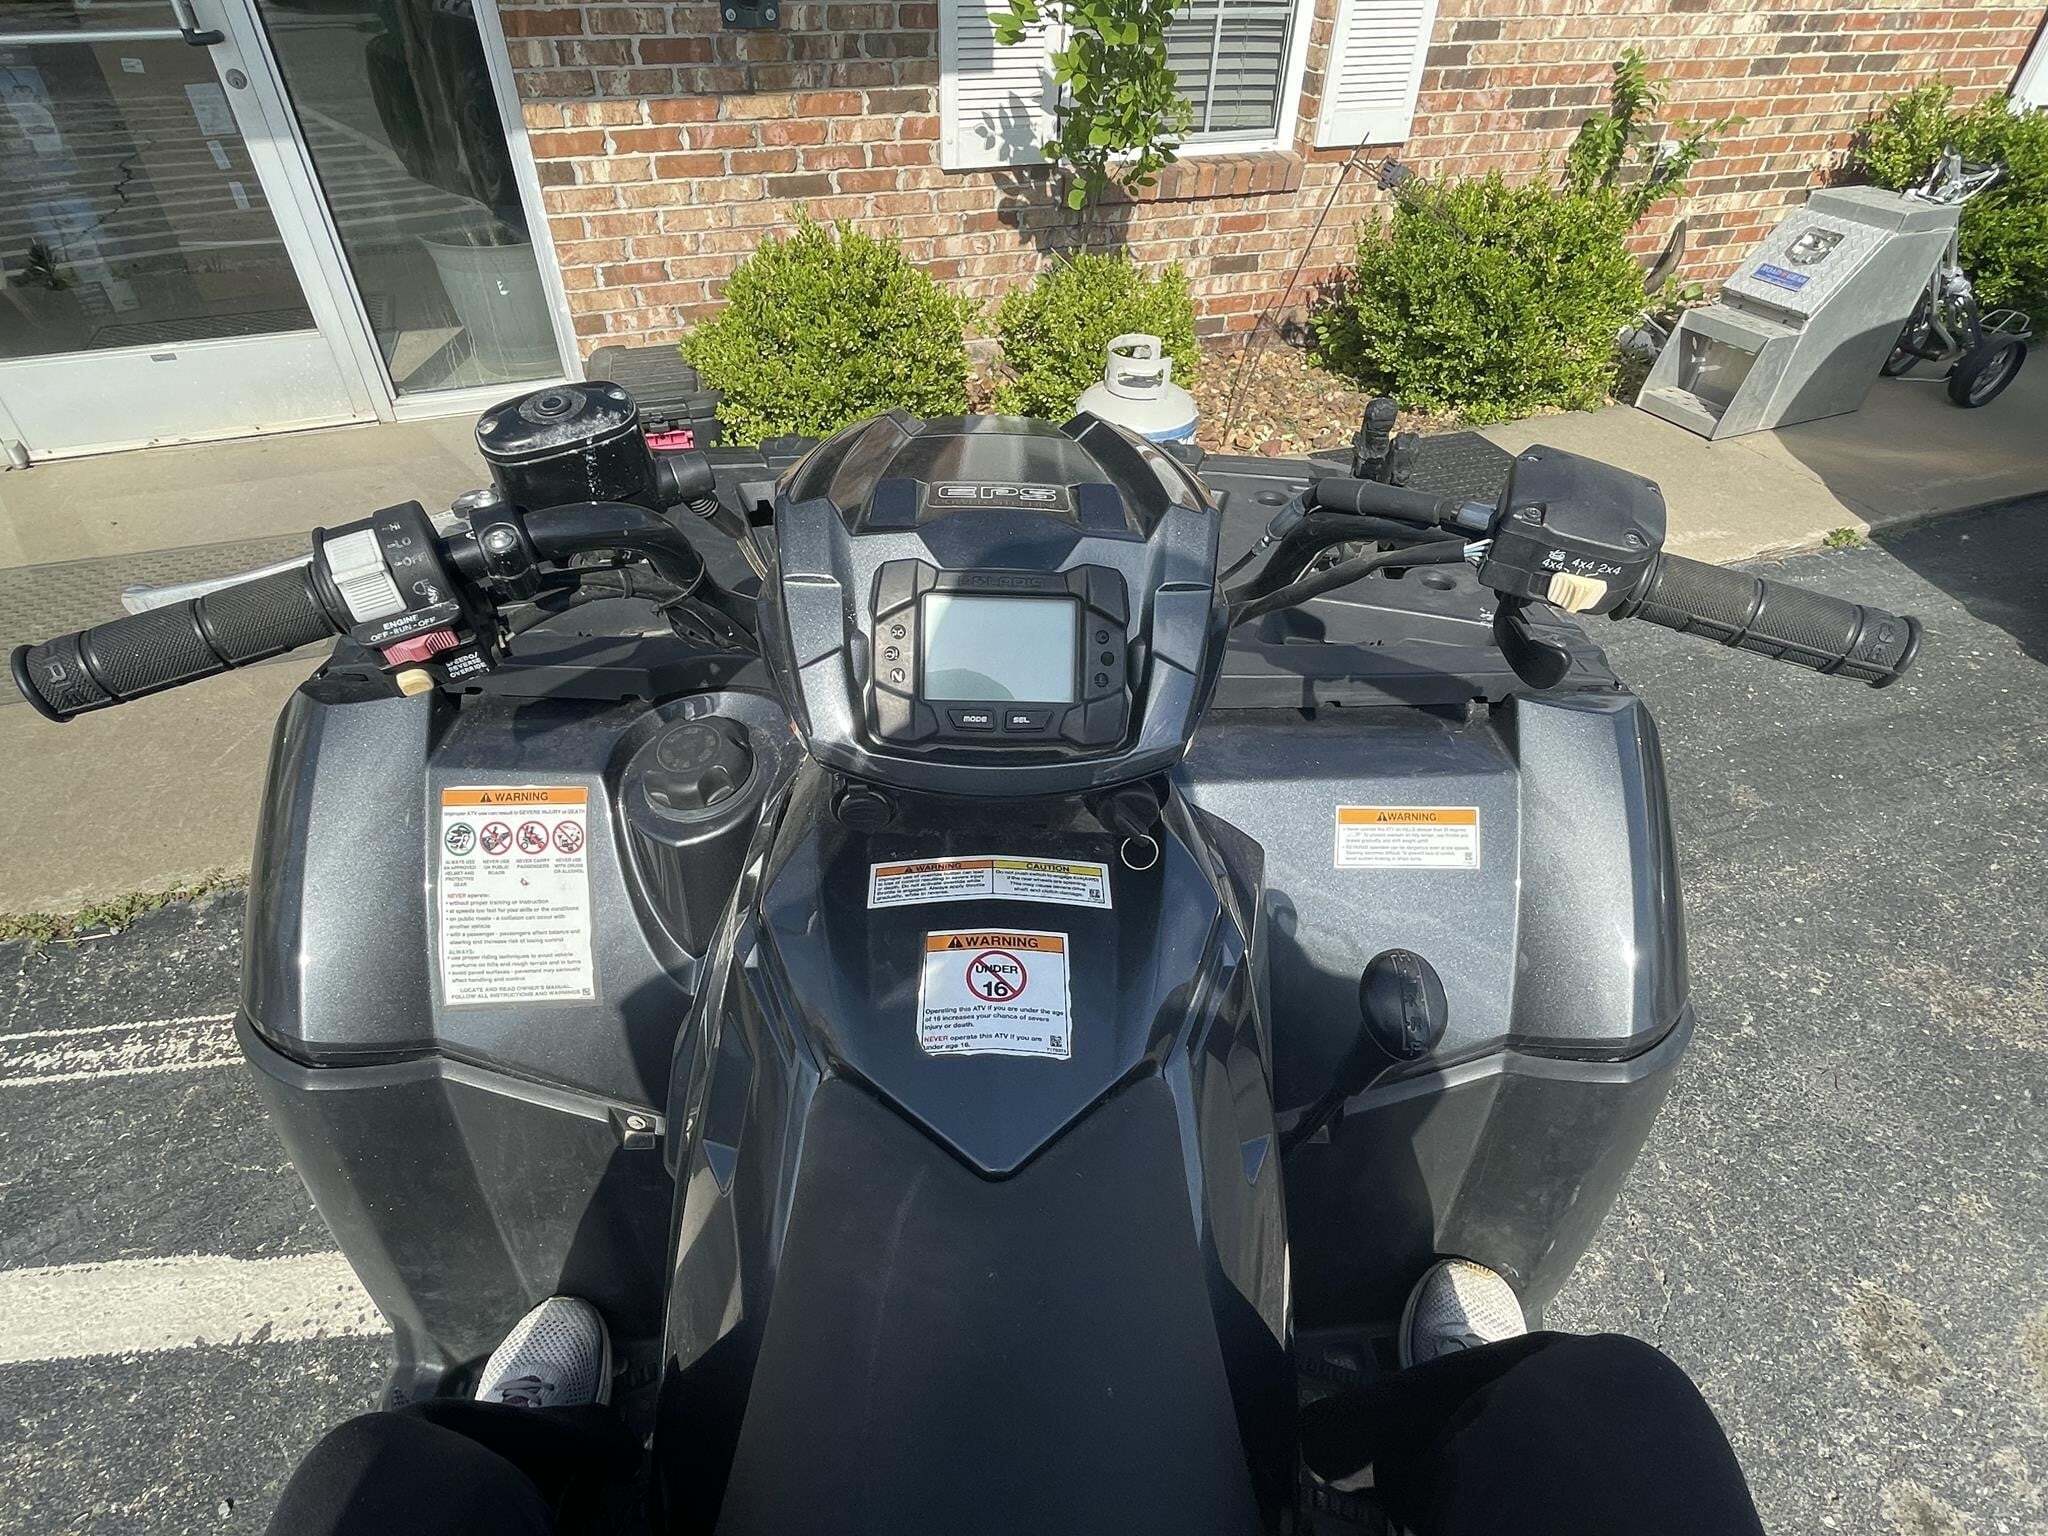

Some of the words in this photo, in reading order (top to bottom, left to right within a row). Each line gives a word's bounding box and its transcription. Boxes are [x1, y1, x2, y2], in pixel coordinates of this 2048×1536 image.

[938, 486, 1057, 502] EPS
[394, 536, 412, 549] LO
[1543, 559, 1564, 570] 4x4
[1572, 559, 1594, 571] 4x4
[1597, 564, 1622, 576] 2x4
[382, 614, 420, 631] ENGINE
[449, 662, 487, 678] OVERRIDE
[963, 715, 988, 723] MODE
[1012, 716, 1030, 724] SEL
[495, 791, 549, 802] WARNING
[1387, 812, 1437, 822] WARNING
[916, 863, 962, 873] WARNING
[1026, 862, 1070, 873] CAUTION
[965, 936, 1039, 948] WARNING
[975, 964, 1018, 975] UNDER
[983, 981, 1009, 997] 16
[925, 1006, 957, 1015] Operating
[1020, 1006, 1039, 1014] under
[976, 1013, 991, 1021] your
[992, 1012, 1018, 1020] chance
[924, 1023, 942, 1031] injury
[924, 1035, 949, 1043] NEVER
[949, 1034, 978, 1042] operate
[924, 1042, 943, 1050] under
